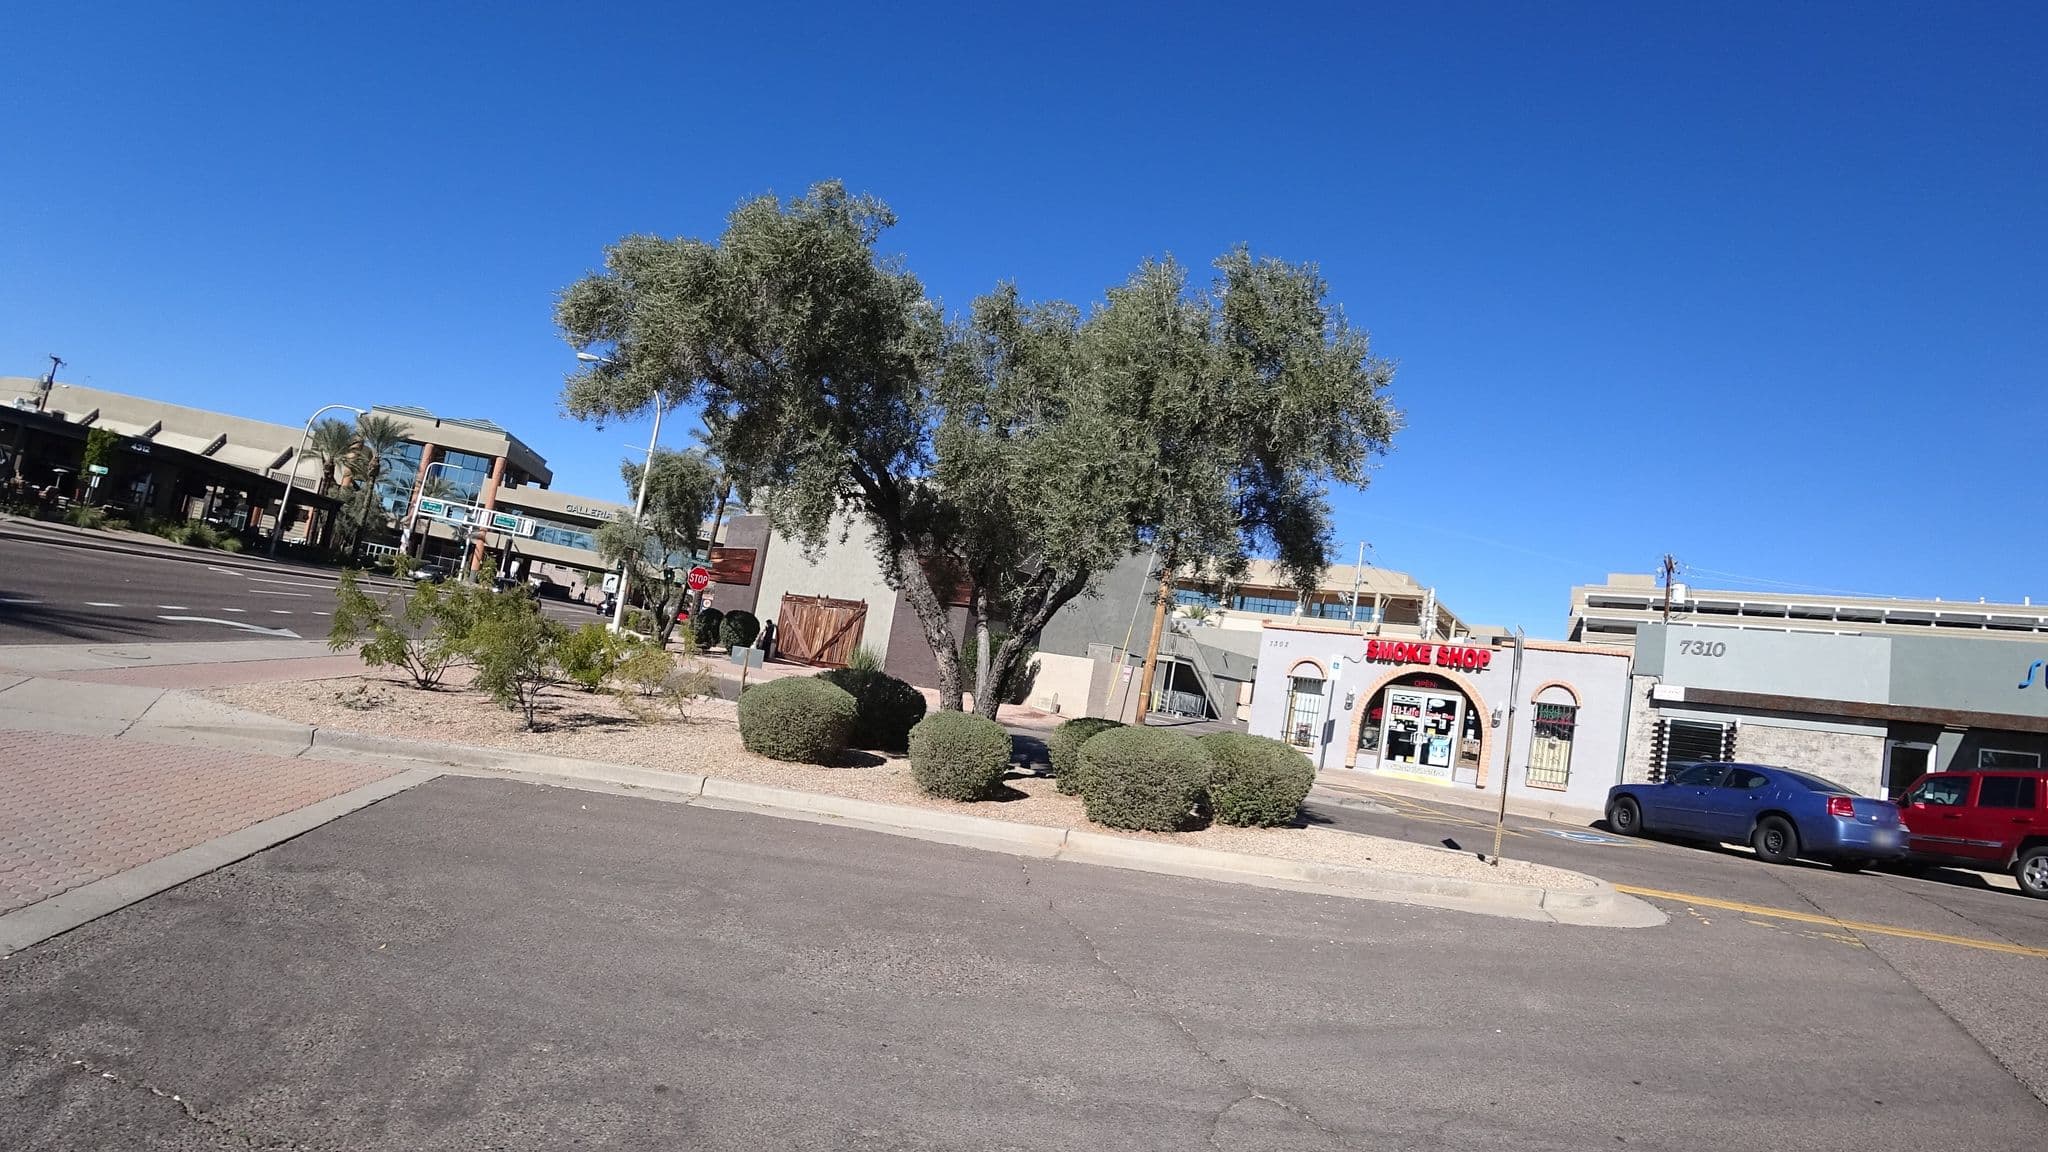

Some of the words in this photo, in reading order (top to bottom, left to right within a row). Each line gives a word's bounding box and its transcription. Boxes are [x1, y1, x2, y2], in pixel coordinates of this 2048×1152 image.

[566, 504, 613, 519] GALLERIA
[689, 573, 708, 584] STOP
[1366, 639, 1432, 665] SMOKE
[1436, 645, 1491, 671] SHOP
[1679, 640, 1726, 658] 7310
[1413, 680, 1436, 688] OPEN
[1391, 705, 1420, 717] Hi-Life
